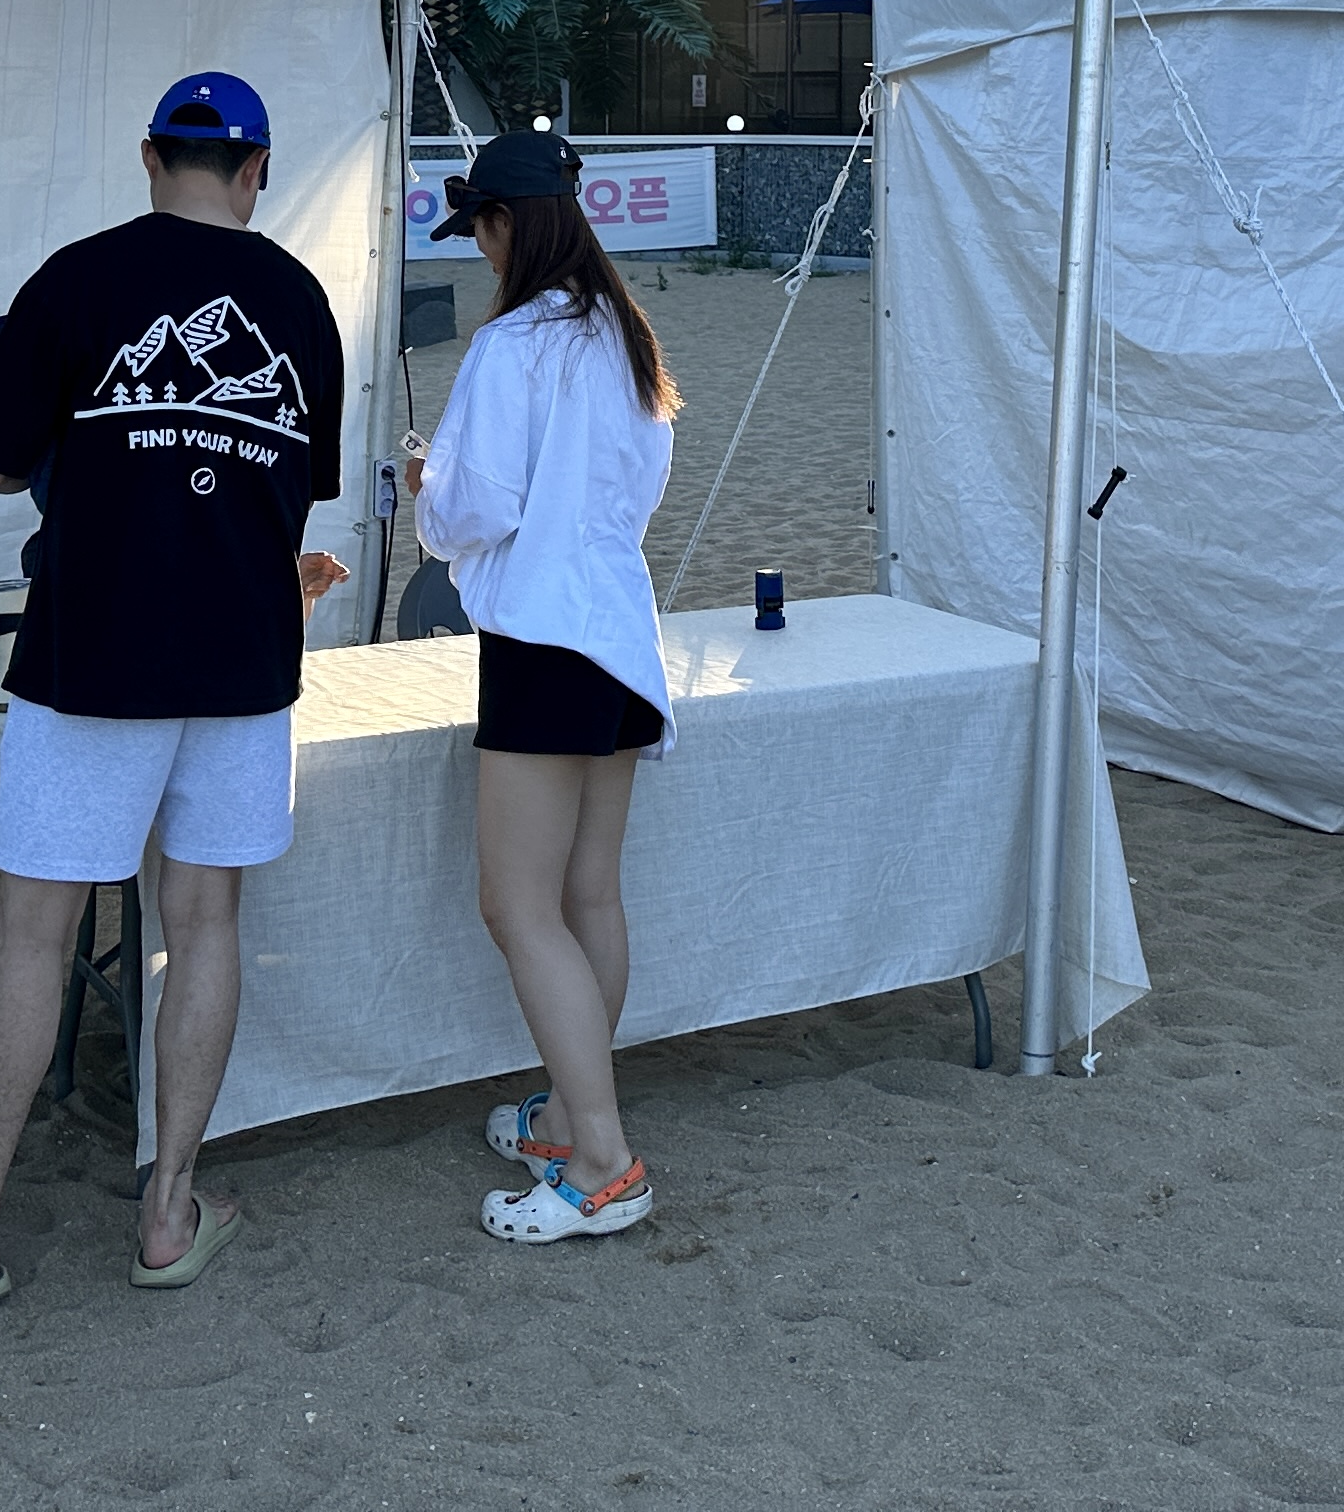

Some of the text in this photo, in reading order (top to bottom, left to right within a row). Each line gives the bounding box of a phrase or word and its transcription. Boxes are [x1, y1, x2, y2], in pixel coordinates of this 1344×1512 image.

[585, 176, 670, 224] 오픈
[128, 429, 279, 467] FIND YOUR WAY
